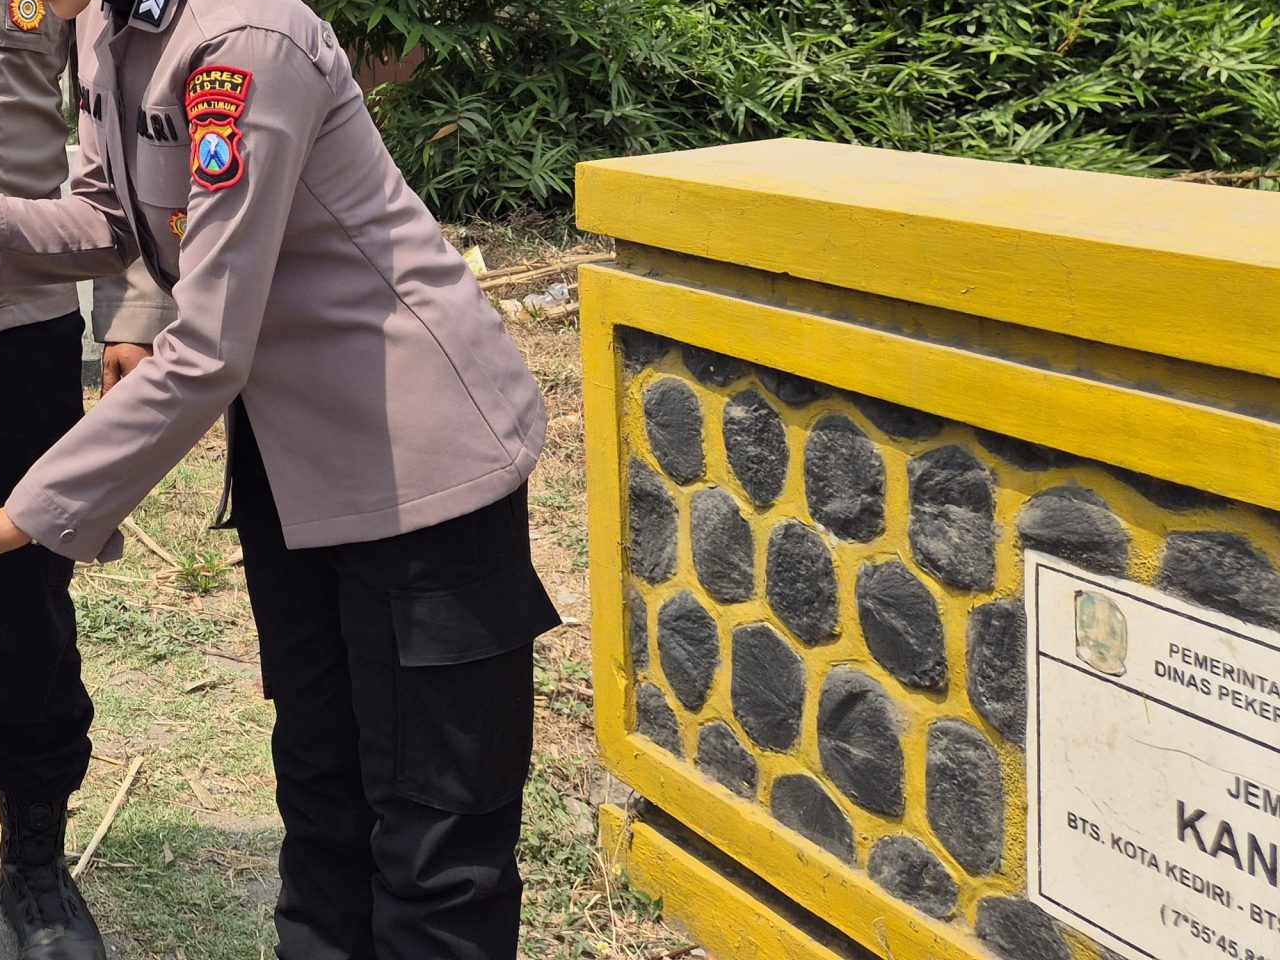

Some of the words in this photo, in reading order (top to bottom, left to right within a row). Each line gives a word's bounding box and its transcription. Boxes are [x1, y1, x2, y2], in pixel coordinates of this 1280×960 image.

[190, 71, 243, 90] POLRES
[209, 101, 237, 113] TIMUR
[1154, 659, 1212, 696] DINAS
[1169, 642, 1280, 699] PEMERINTA
[1177, 799, 1278, 889] KAN
[1067, 811, 1106, 845] BTS.
[1111, 832, 1161, 874] KOTA
[1165, 860, 1231, 909] KEDIRI
[1250, 903, 1280, 935] BT
